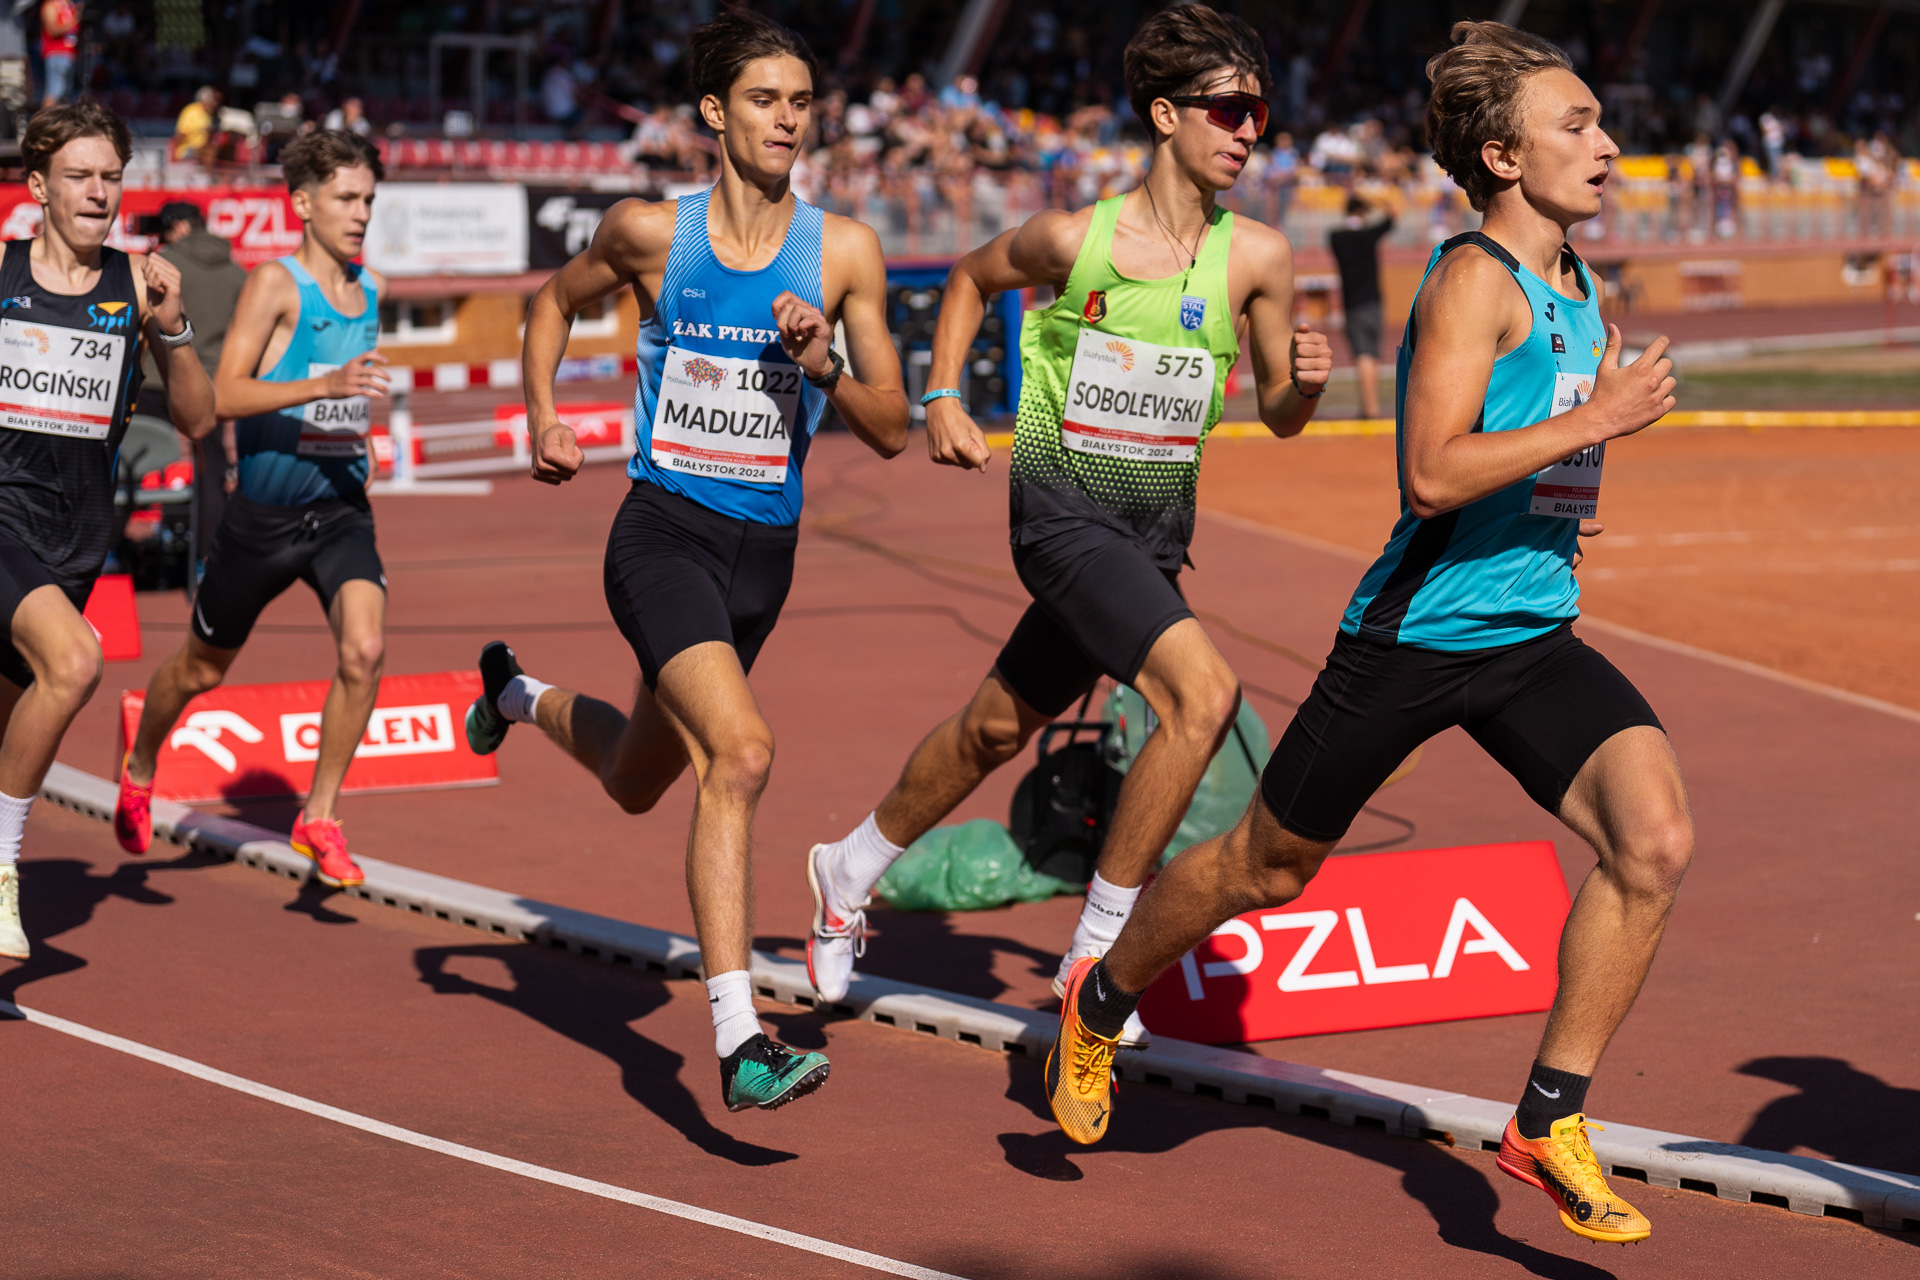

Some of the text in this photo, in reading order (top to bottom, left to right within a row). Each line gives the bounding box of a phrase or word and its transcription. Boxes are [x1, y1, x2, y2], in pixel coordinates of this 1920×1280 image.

[207, 198, 303, 247] PZL
[682, 287, 706, 299] esa
[1182, 301, 1203, 311] STAL
[87, 304, 132, 334] Sopot
[673, 318, 780, 344] ŻAK PYRZY
[70, 336, 112, 361] 734
[1083, 349, 1117, 364] Białystok
[1155, 354, 1203, 379] 575
[0, 365, 111, 402] ROGIŃSKI
[736, 367, 799, 395] 1022
[1073, 381, 1204, 422] SOBOLEWSKI
[664, 398, 786, 440] MADUZIA
[1081, 439, 1145, 455] BIAŁYSTOK
[1147, 448, 1173, 457] 2024
[672, 457, 766, 479] BIAŁYSTOK 2024
[1553, 503, 1597, 515] BIAŁYSTO
[295, 716, 439, 750] OLEN
[1180, 897, 1531, 1001] PZLA
